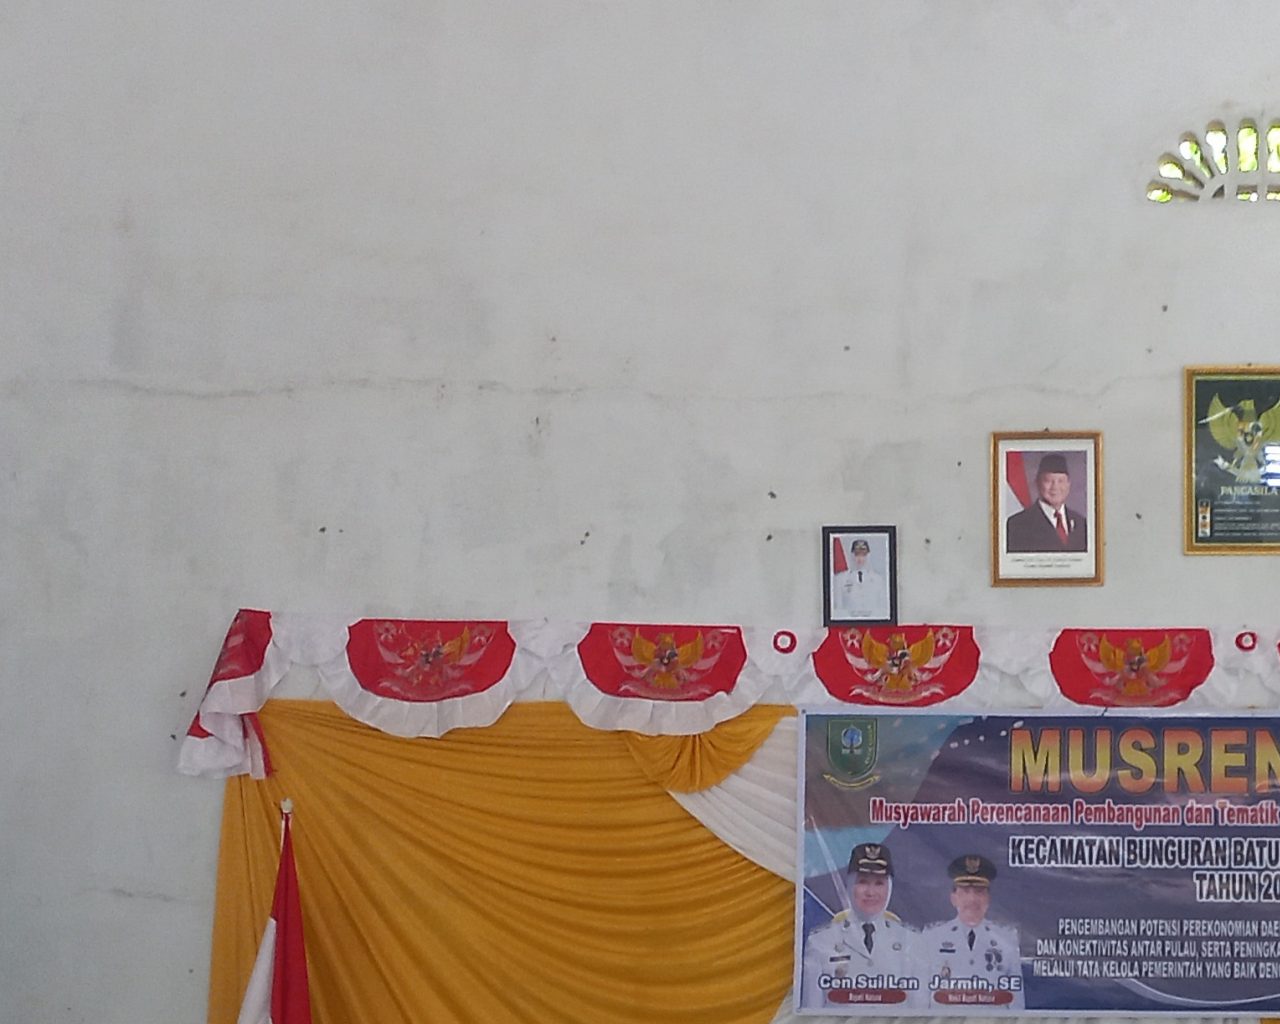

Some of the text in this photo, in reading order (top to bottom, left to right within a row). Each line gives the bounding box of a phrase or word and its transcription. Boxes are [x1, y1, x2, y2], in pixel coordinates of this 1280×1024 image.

[870, 798, 967, 829] Musyawarah
[969, 798, 1070, 824] Perencanaan
[1074, 798, 1182, 831] Pembangunan
[1184, 799, 1214, 825] dan
[1217, 800, 1280, 826] Tematik
[1009, 836, 1122, 867] KECAMATAN
[1124, 837, 1229, 868] BUNGURAN
[1193, 871, 1259, 902] TAHUN
[1058, 918, 1138, 935] PENGEMBANGAN
[1139, 919, 1181, 936] POTENSI
[1183, 920, 1259, 937] PEREKONOMIAN
[1037, 939, 1057, 955] DAN
[1058, 939, 1129, 956] KONEKTIVITAS
[1131, 940, 1163, 957] ANTAR
[1165, 940, 1199, 960] PULAU,
[1201, 941, 1232, 957] SERTA
[1033, 960, 1074, 976] MELALUI
[1077, 961, 1100, 977] TATA
[1102, 961, 1140, 977] KELOLA
[1142, 961, 1203, 978] PEMERINTAH
[1205, 962, 1232, 978] YANG
[1234, 962, 1258, 978] BAIK
[819, 974, 854, 989] Cen
[888, 975, 919, 990] Lan
[929, 975, 1021, 992] Jarmin, SE
